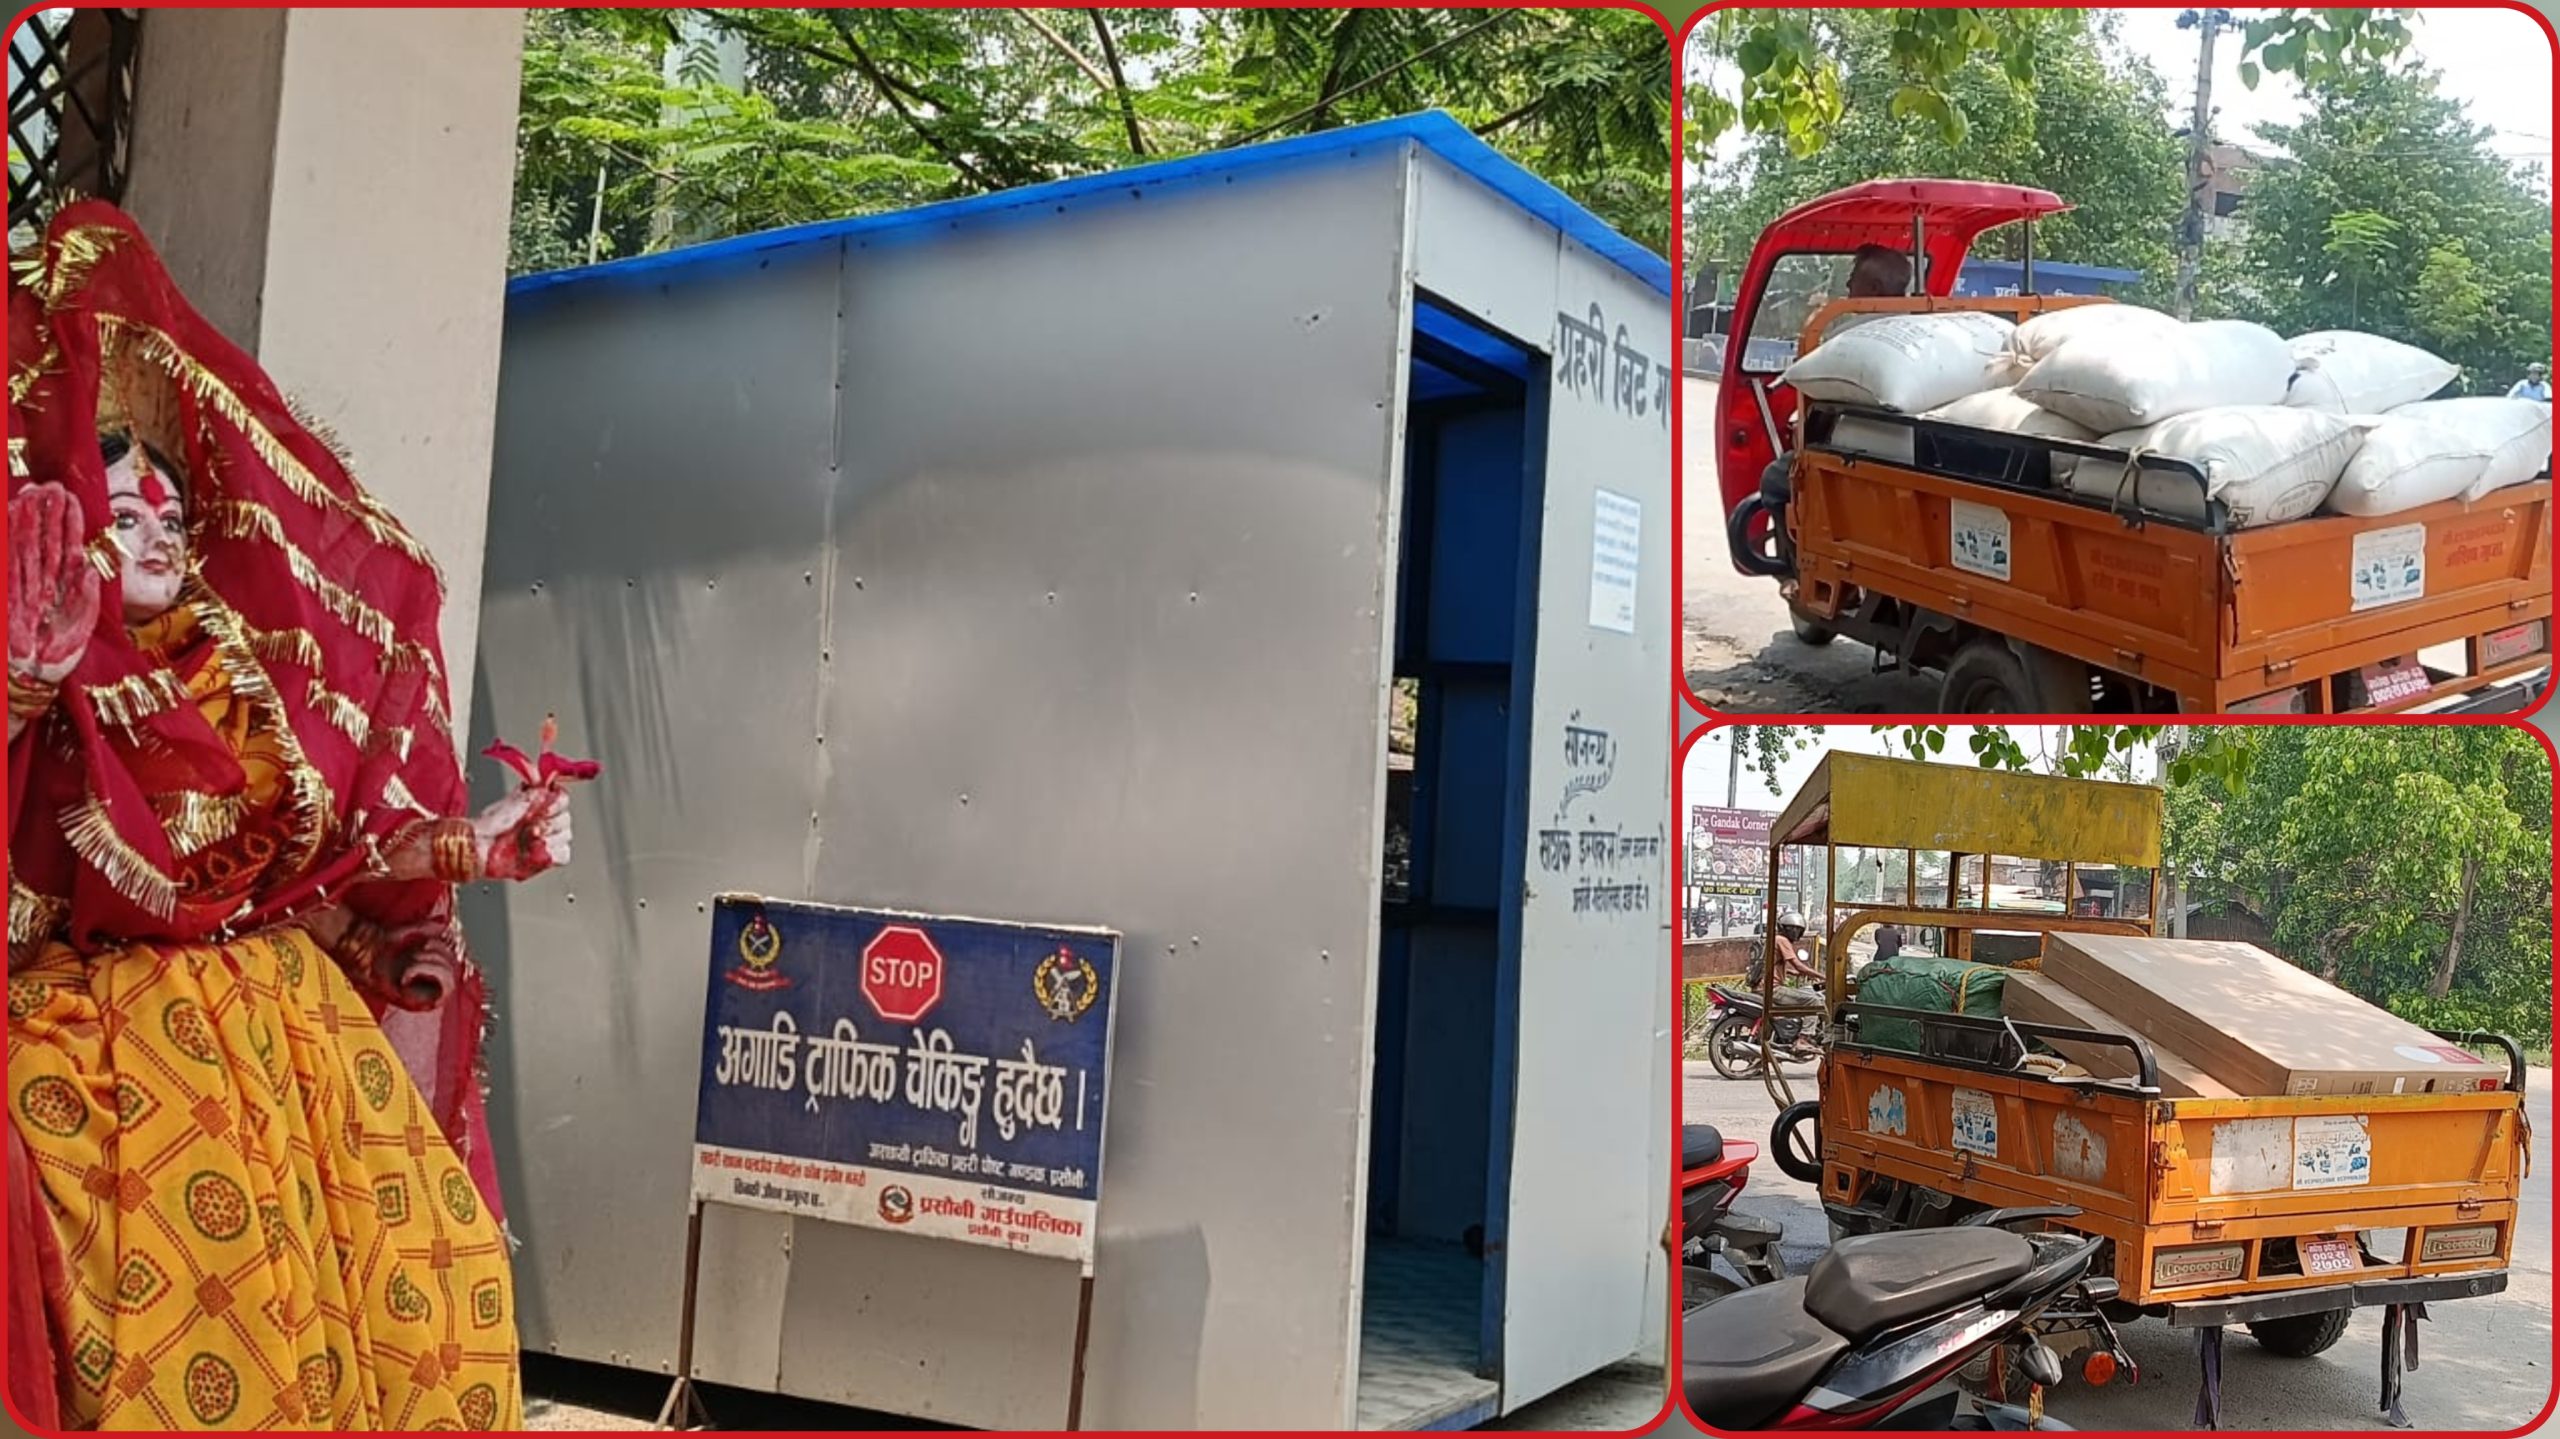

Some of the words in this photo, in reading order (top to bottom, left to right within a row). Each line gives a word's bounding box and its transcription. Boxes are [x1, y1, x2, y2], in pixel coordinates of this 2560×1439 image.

[1557, 301, 1607, 404] प्रहरी
[1694, 814, 1709, 826] The
[1710, 815, 1741, 829] Gandak
[1742, 817, 1769, 831] Corner
[869, 957, 934, 990] STOP
[716, 1010, 800, 1090] अगाडि
[804, 1018, 900, 1113] ट्राफिक
[2312, 1258, 2353, 1271] २७०२
